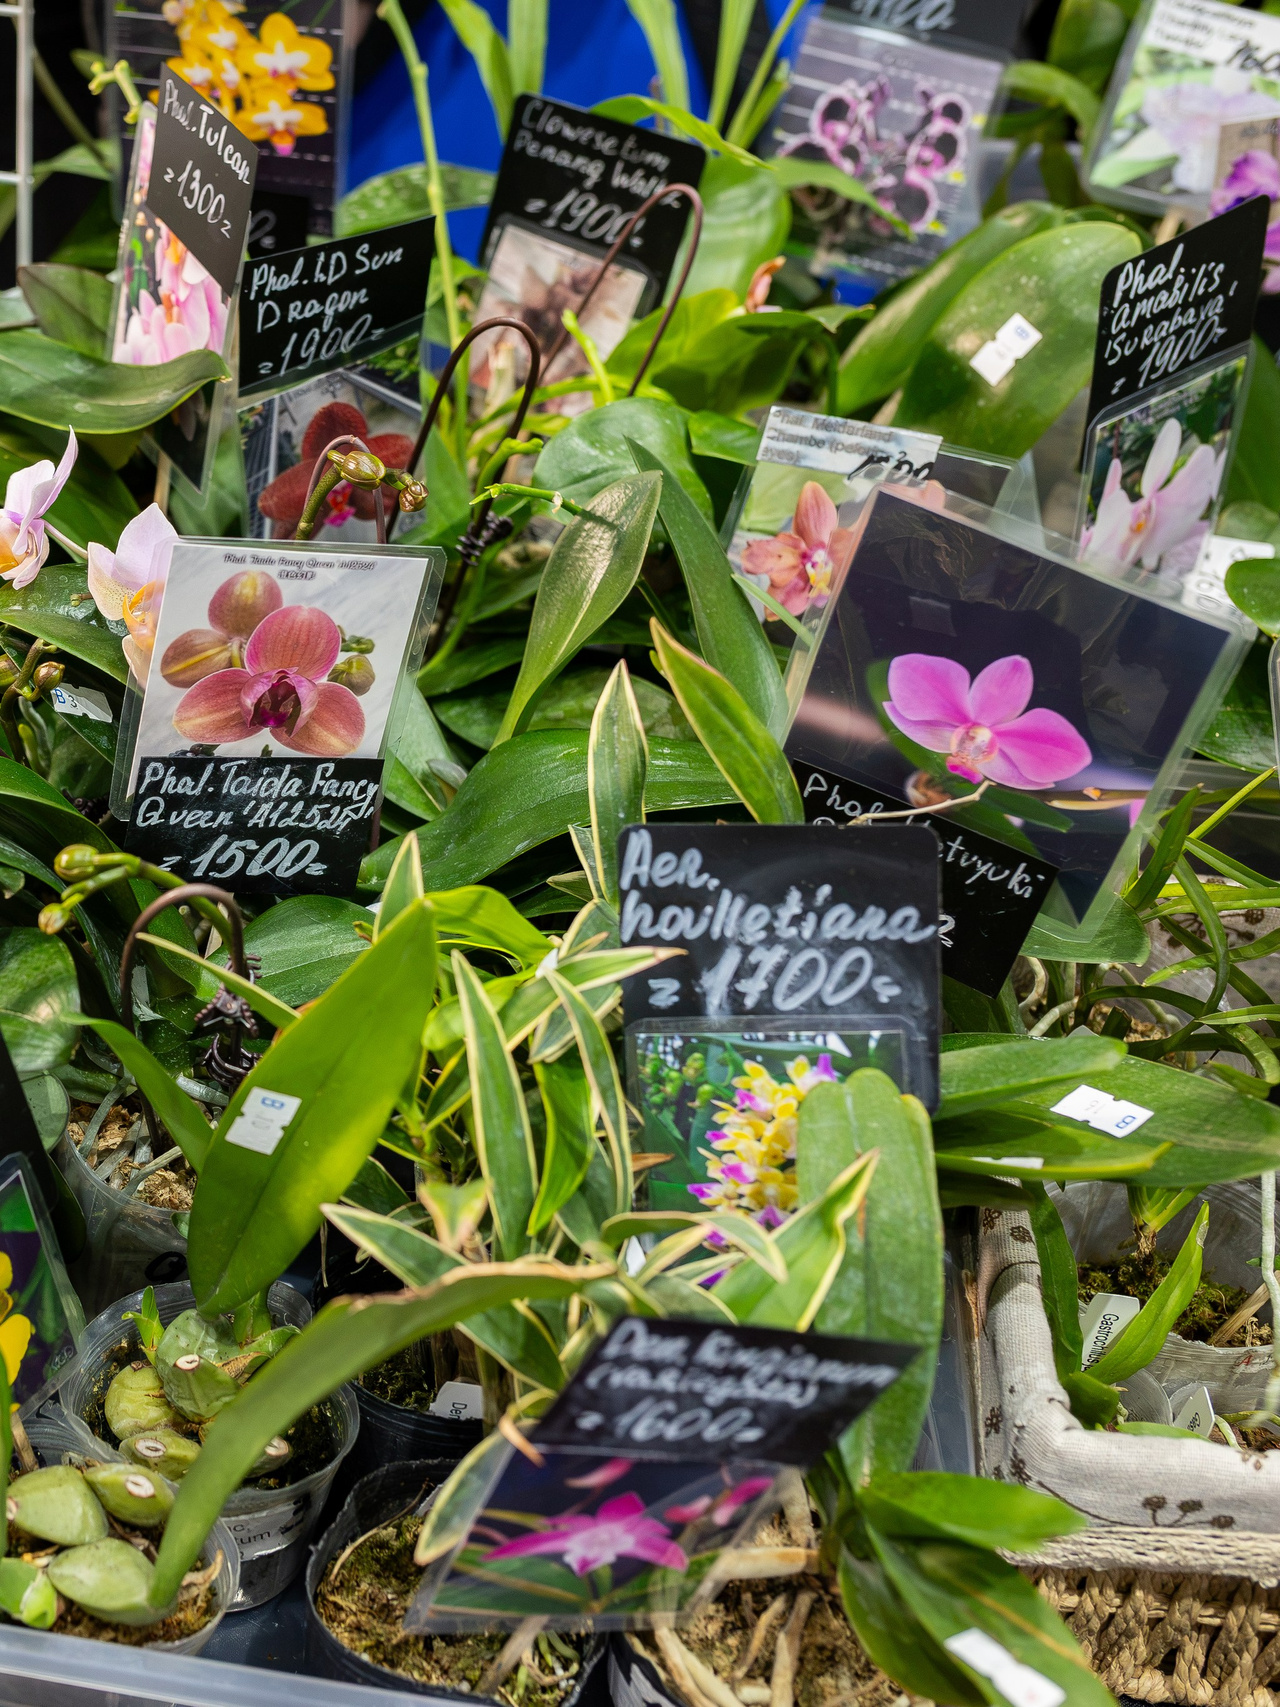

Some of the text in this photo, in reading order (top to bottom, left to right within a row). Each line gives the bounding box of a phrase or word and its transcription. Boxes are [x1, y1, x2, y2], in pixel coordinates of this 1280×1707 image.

[249, 256, 308, 300] Phal.
[355, 243, 404, 275] Sun
[1113, 243, 1186, 308] Phal.
[136, 796, 233, 829] Queen
[139, 760, 380, 820] Phal. Taida Fancy
